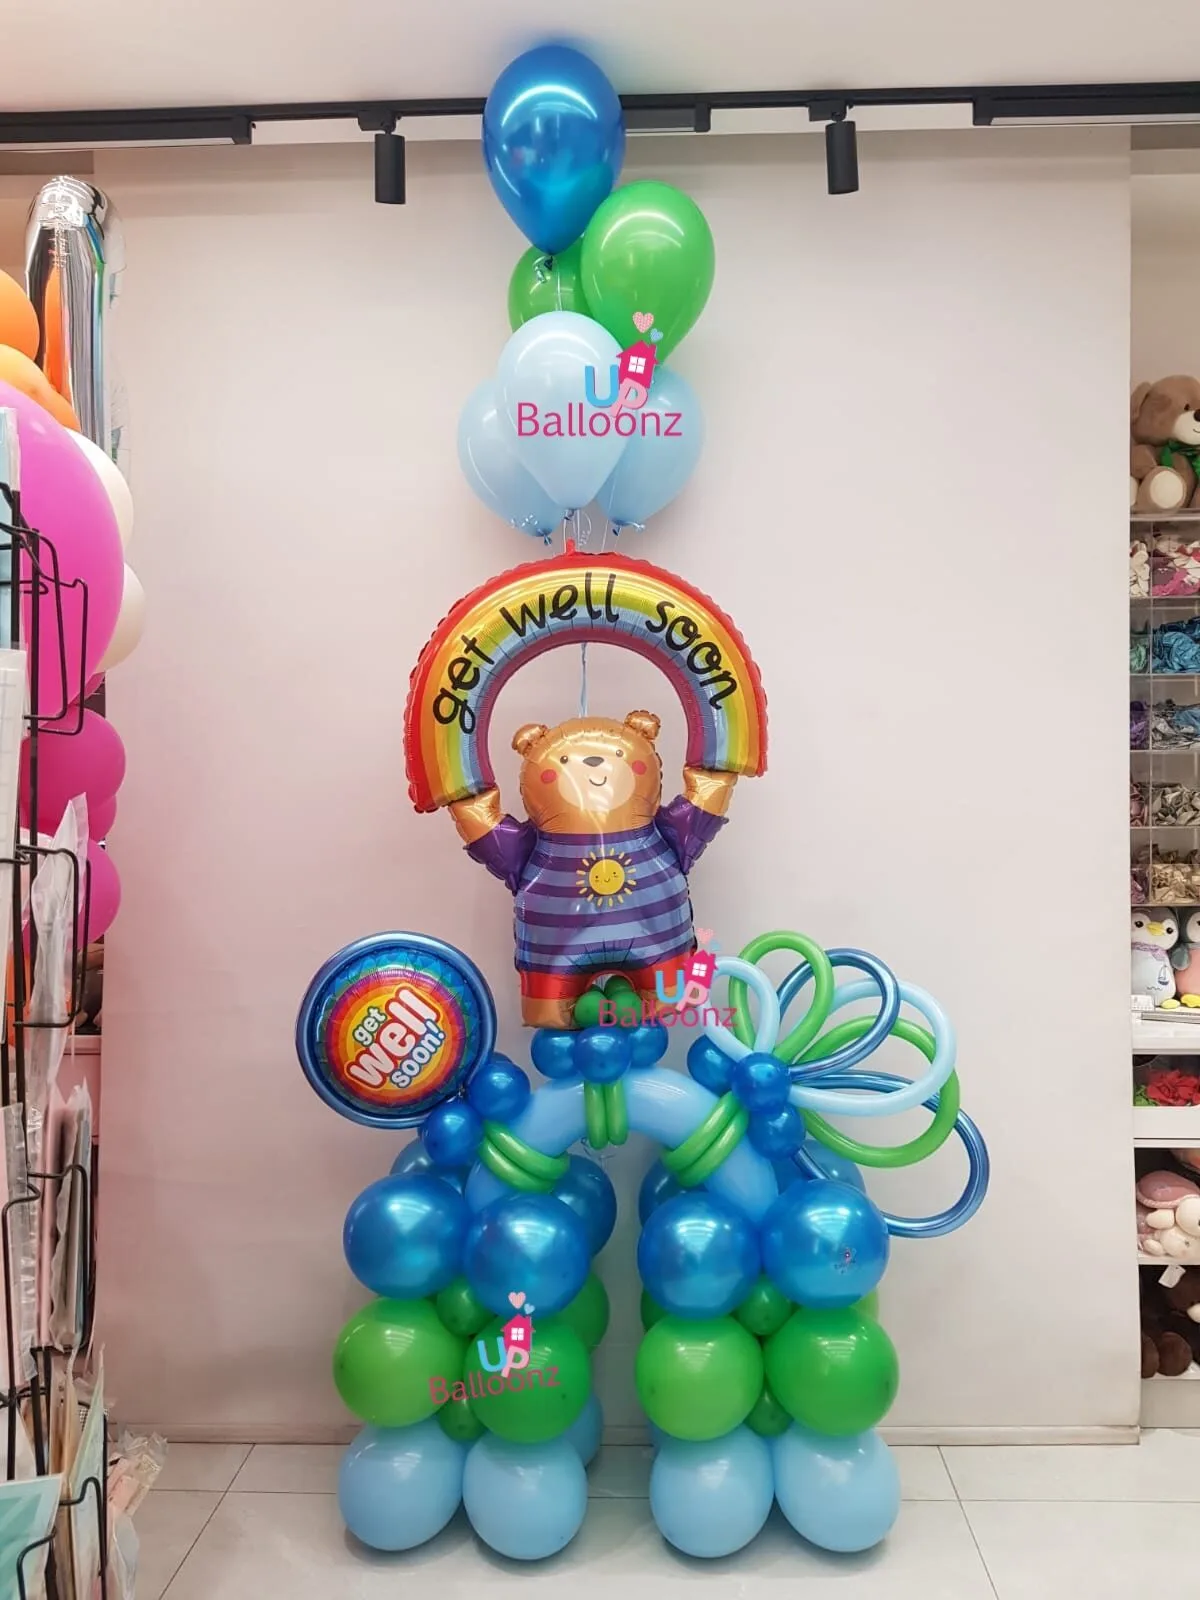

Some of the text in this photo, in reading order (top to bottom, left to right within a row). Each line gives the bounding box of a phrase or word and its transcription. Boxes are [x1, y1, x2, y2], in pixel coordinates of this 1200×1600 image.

[432, 572, 738, 735] get well soon
[348, 987, 439, 1087] well
[352, 1006, 388, 1048] get
[390, 1018, 447, 1088] soon!
